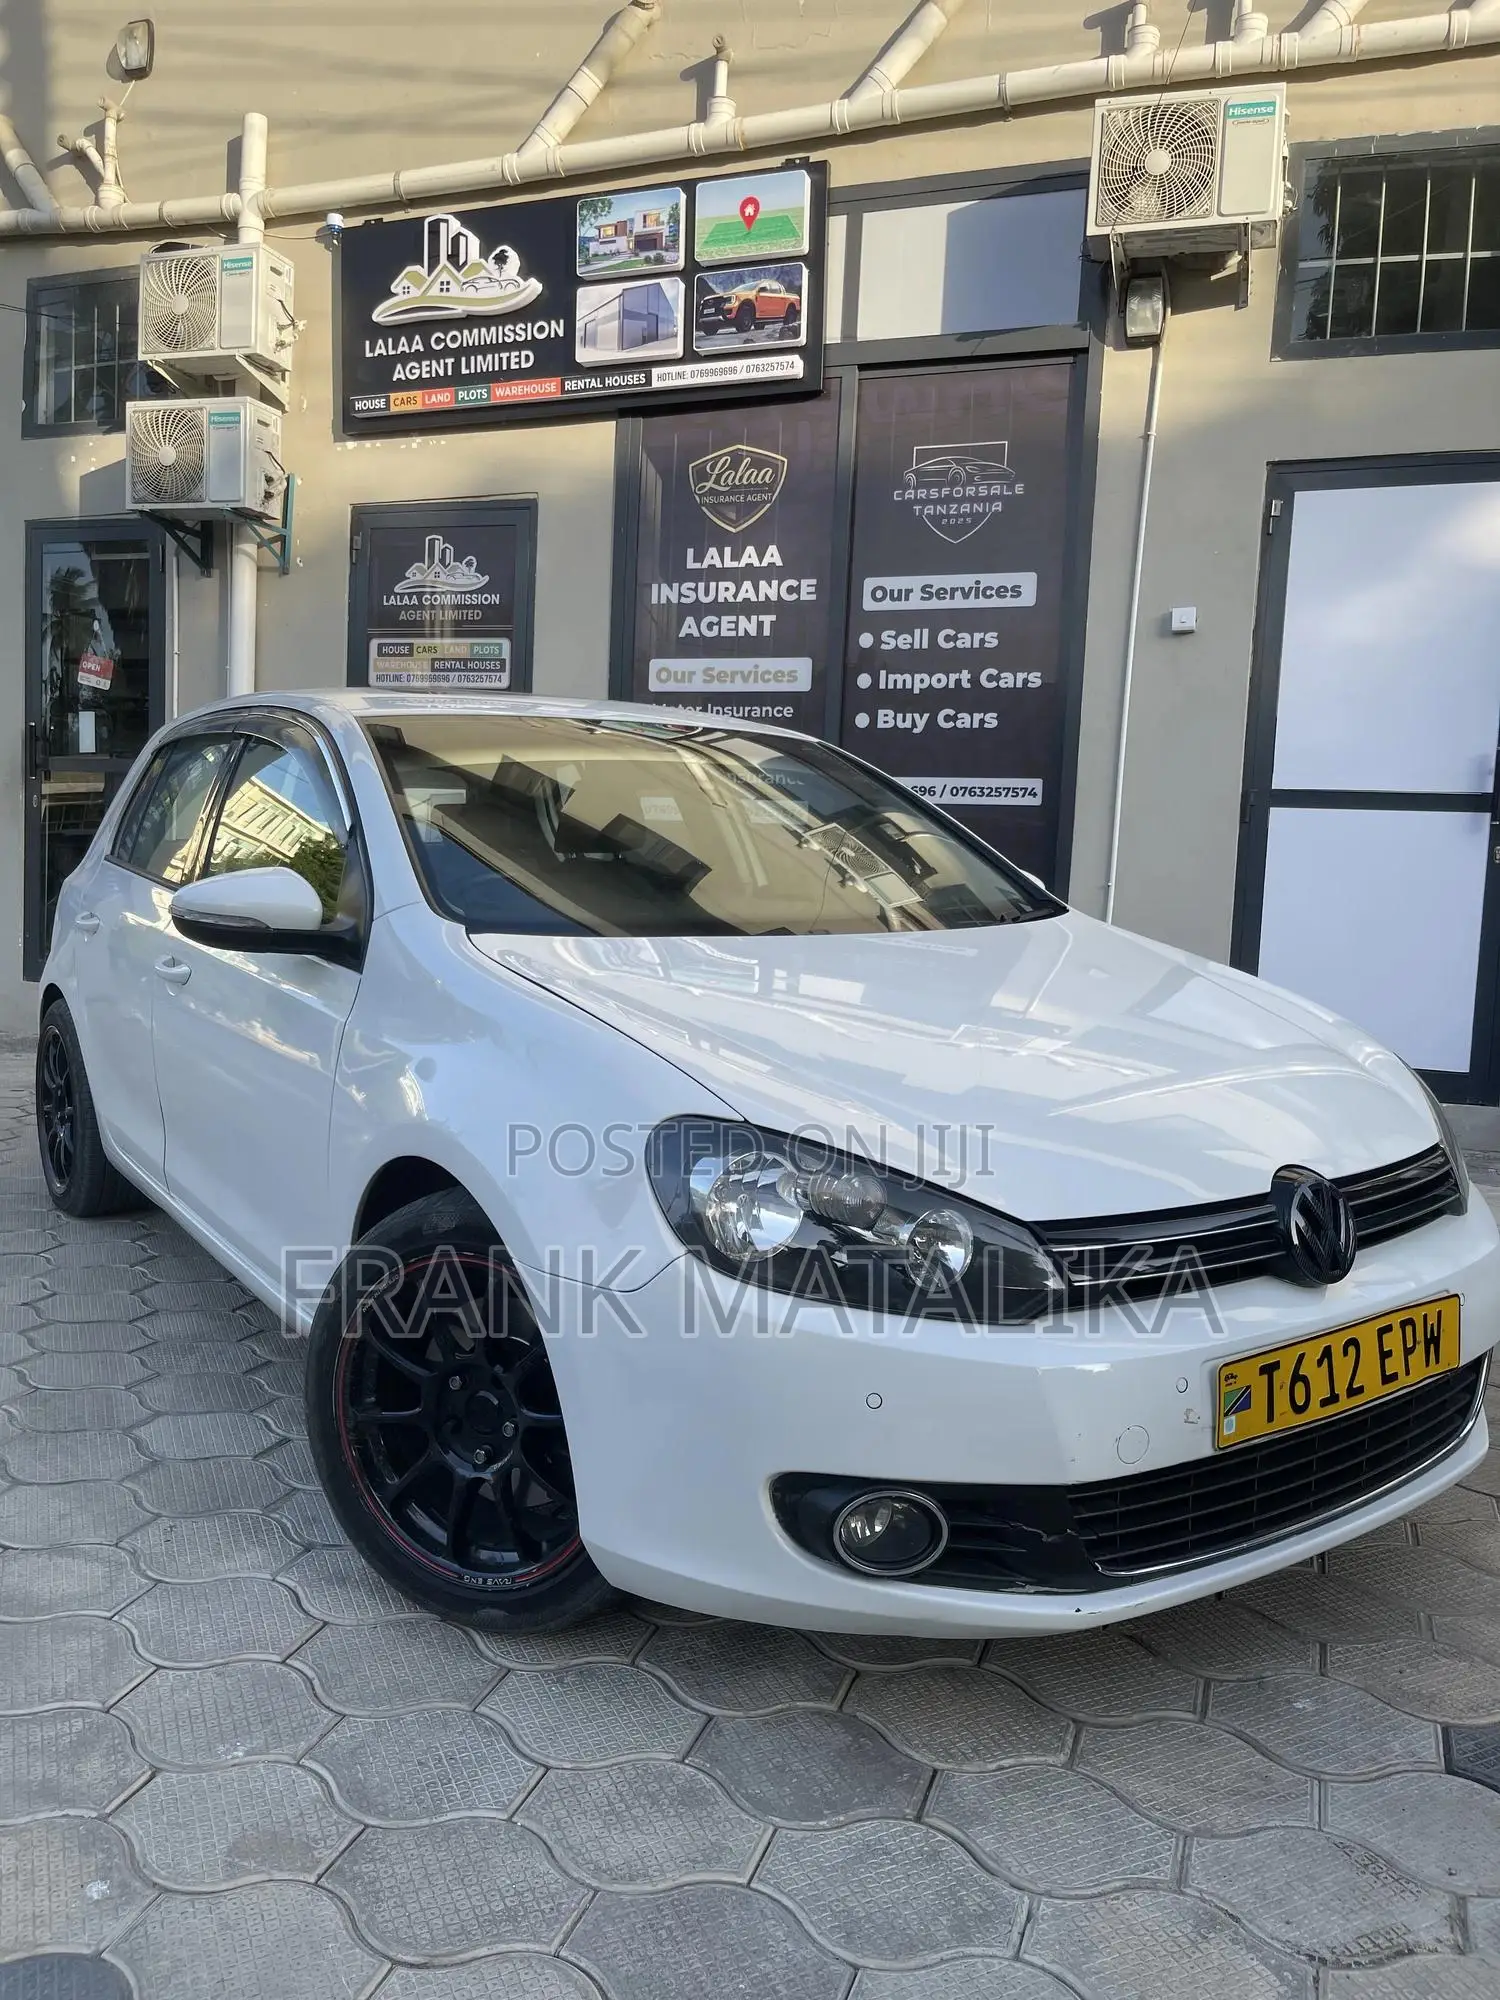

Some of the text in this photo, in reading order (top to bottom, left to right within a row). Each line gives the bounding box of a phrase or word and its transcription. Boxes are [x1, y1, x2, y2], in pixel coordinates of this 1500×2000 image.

[1229, 106, 1274, 116] Hisense
[365, 319, 565, 358] LALAA COMMISSION
[392, 350, 535, 382] AGENT LIMITED
[355, 398, 386, 411] HOUSE
[393, 395, 418, 407] CARS
[425, 393, 451, 404] LAND
[458, 389, 488, 401] PLOTS
[495, 382, 557, 398] WAREHOUSE
[564, 377, 604, 391] RENTAL
[605, 373, 646, 388] HOUSES
[657, 370, 688, 382] HOTLINE:
[690, 365, 738, 379] 0769969696
[745, 361, 795, 375] 0763257574
[695, 455, 776, 494] Lalaa
[701, 493, 772, 504] INSURANCE AGENT
[893, 483, 1025, 501] CARSFORSALE
[913, 502, 1002, 516] TANZANIA
[941, 517, 973, 525] 2025
[686, 545, 783, 570] LALAA
[383, 593, 500, 606] LALAA COMMISSION
[651, 578, 817, 605] INSURANCE
[870, 579, 1022, 602] Our Services
[399, 609, 483, 621] AGENT LIMITED
[678, 615, 777, 638] AGENT
[880, 628, 999, 650] Sell Cars
[382, 645, 500, 654] HOUSE CARS LAND PLOTS
[82, 661, 101, 672] OPEN
[434, 661, 466, 670] RENTAL
[467, 661, 501, 670] HOUSES
[655, 664, 799, 684] Our Services
[375, 673, 404, 683] HOTLINE:
[457, 674, 502, 683] 0763257574
[878, 668, 1042, 694] Import Cars
[708, 703, 794, 718] Insurance
[876, 708, 998, 734] Buy Cars
[939, 784, 947, 798] /
[950, 785, 1038, 798] 0763257574
[1376, 1309, 1443, 1387] EPW
